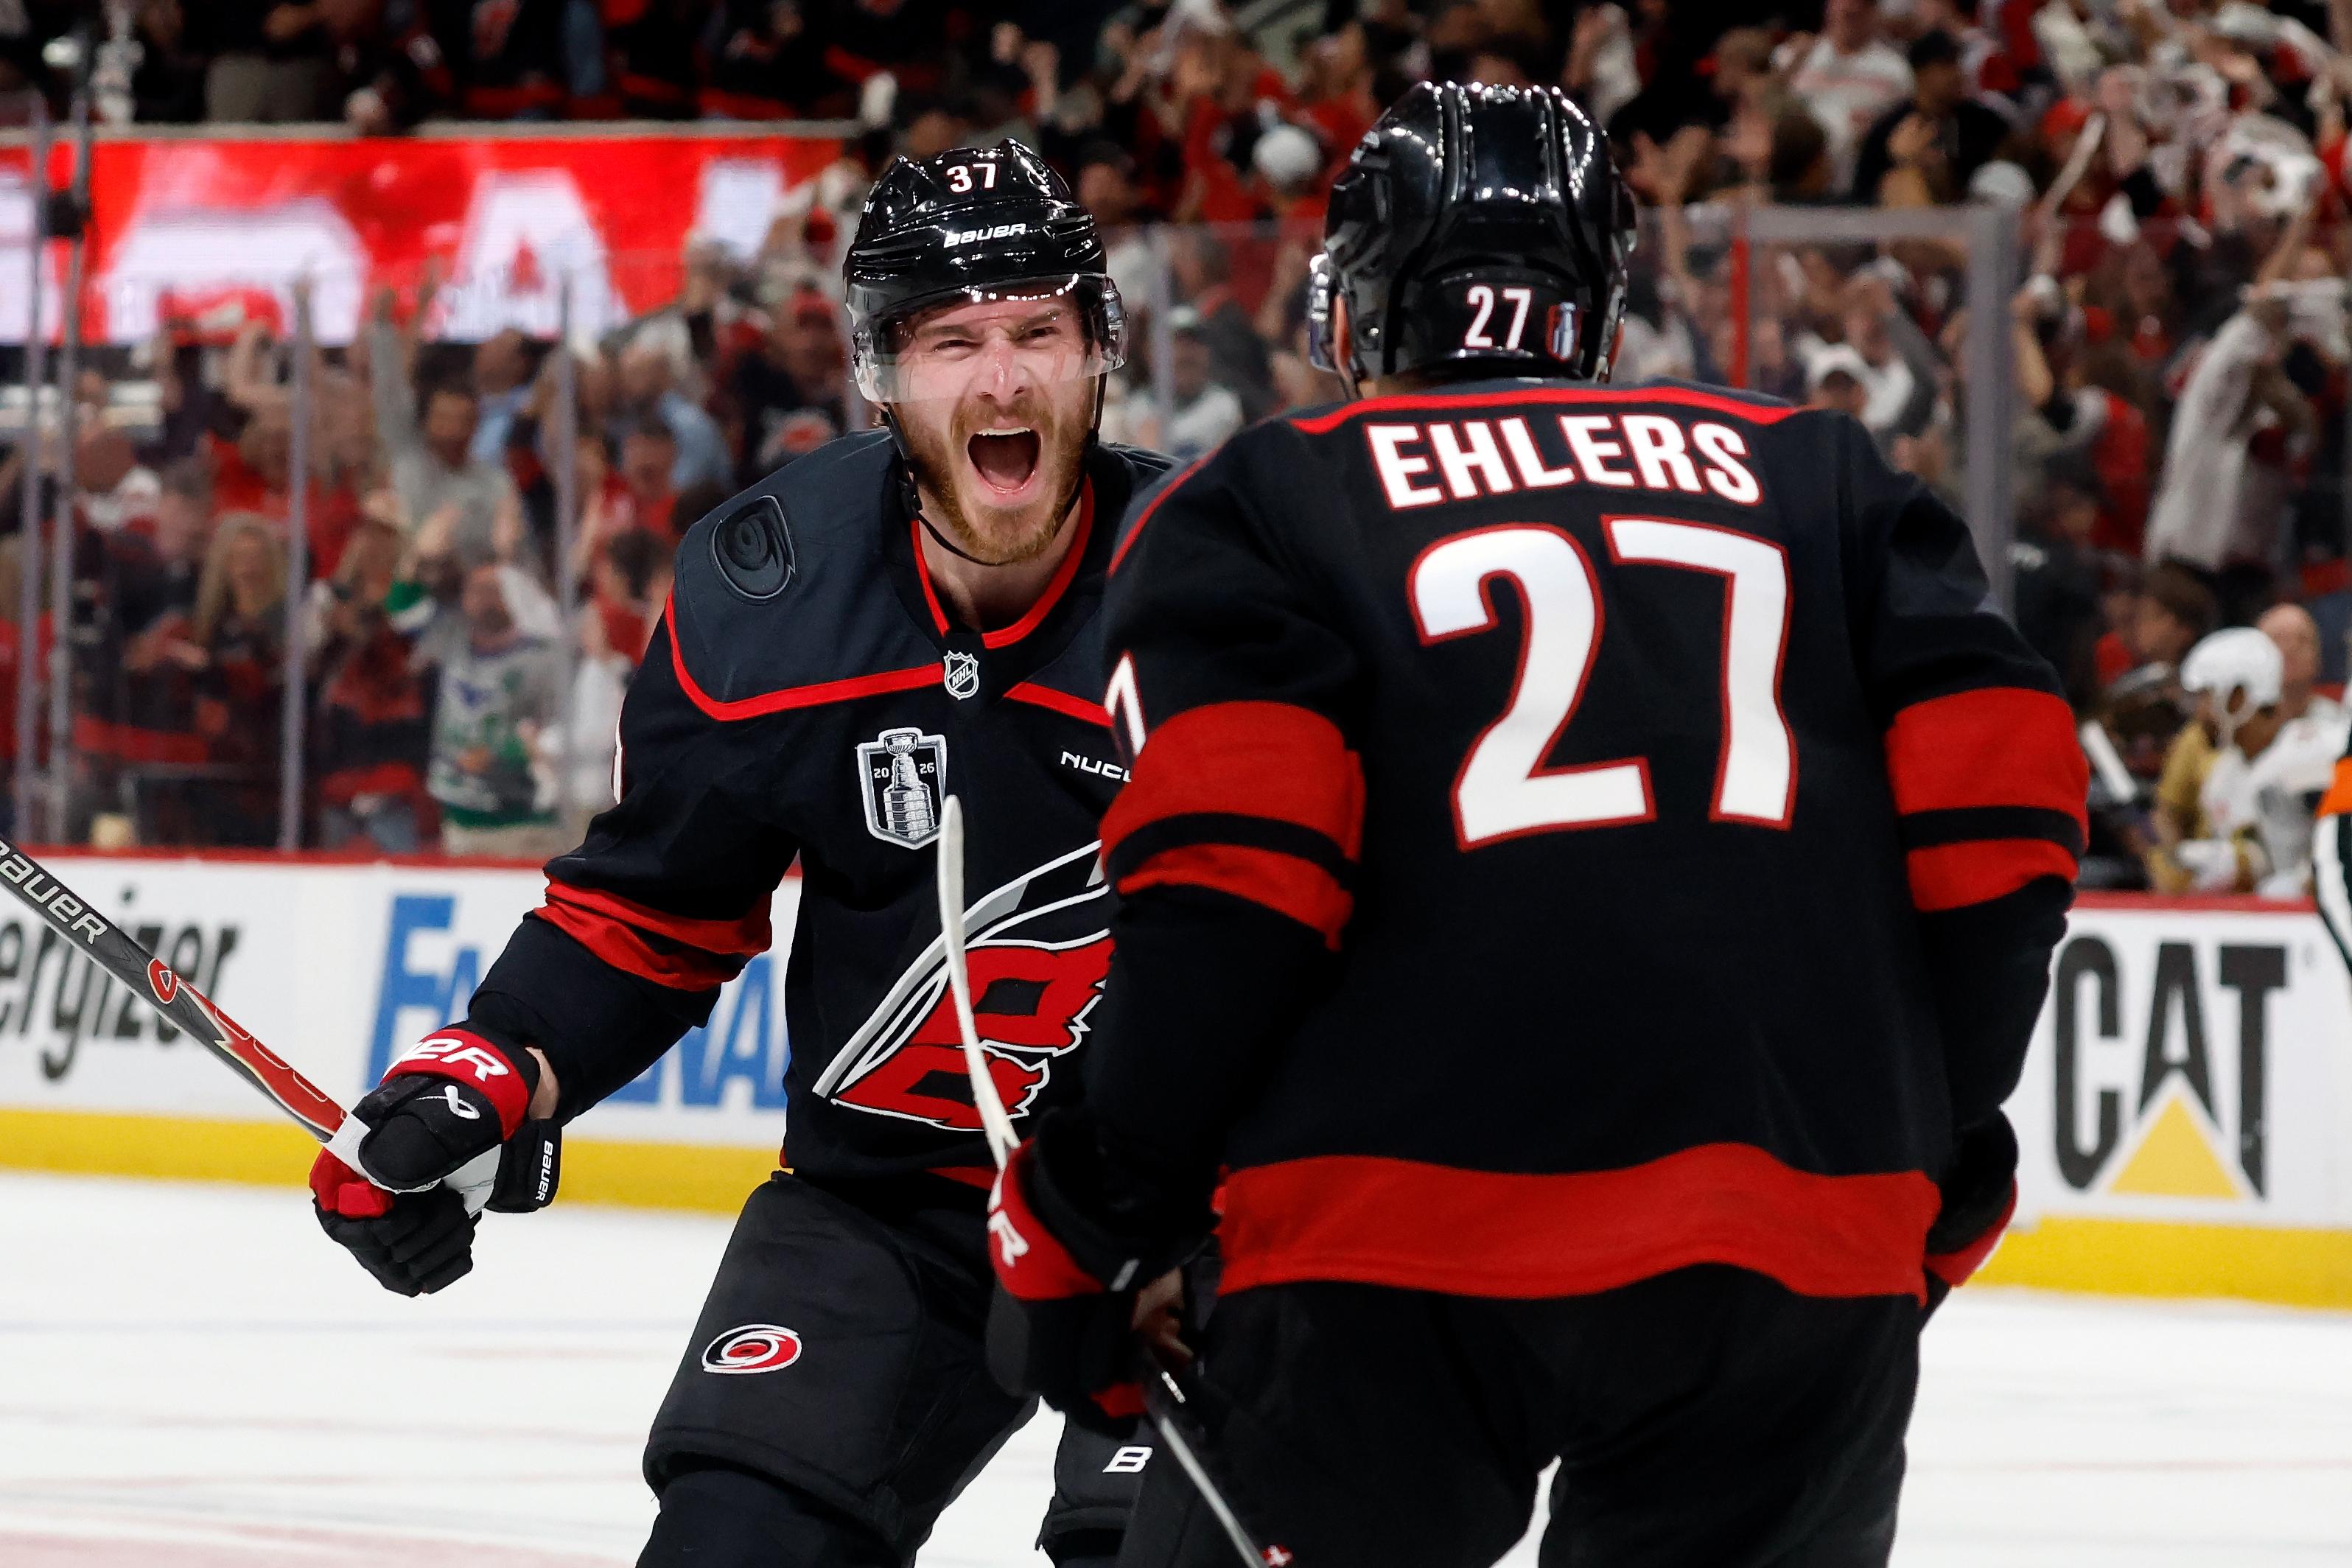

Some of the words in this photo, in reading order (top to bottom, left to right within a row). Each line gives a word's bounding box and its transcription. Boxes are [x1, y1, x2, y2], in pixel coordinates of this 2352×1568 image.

[946, 162, 998, 193] 37
[1464, 284, 1532, 350] 27
[1366, 415, 1763, 508] EHLERS
[952, 665, 972, 687] NHL
[1406, 514, 1797, 852] 27
[873, 767, 889, 779] 20
[919, 762, 935, 774] 26
[2055, 935, 2287, 1200] CAT
[1102, 1446, 1153, 1474] B
